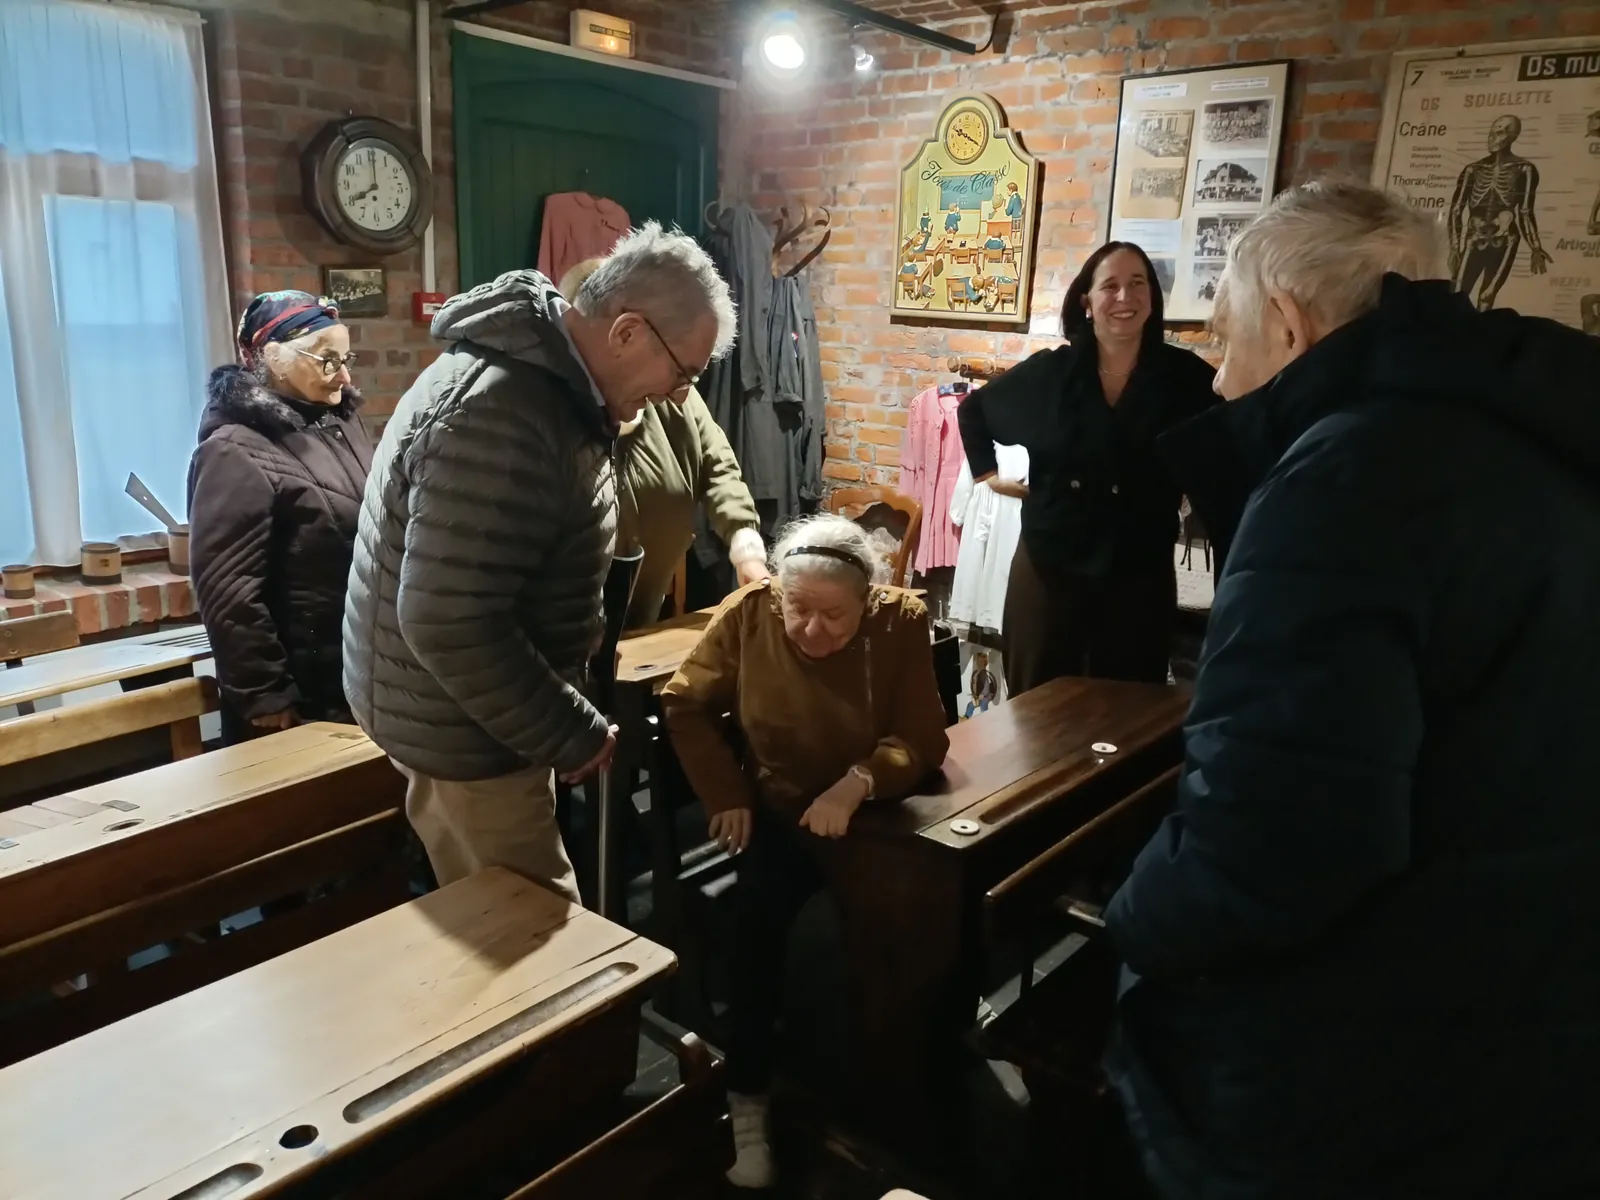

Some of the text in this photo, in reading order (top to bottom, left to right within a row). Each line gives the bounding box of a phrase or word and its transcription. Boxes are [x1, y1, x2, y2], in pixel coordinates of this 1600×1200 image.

[1411, 70, 1424, 86] 7
[1399, 121, 1447, 136] Crâne
[383, 156, 387, 167] 1
[345, 164, 355, 176] 10
[952, 179, 968, 194] de
[970, 160, 1011, 195] Classe
[1392, 175, 1426, 186] Thorax
[343, 180, 350, 190] 9
[397, 183, 404, 194] 3
[348, 195, 355, 206] 8
[394, 197, 401, 209] 4
[360, 206, 366, 218] 7
[373, 211, 380, 223] 6
[386, 208, 393, 219] 5
